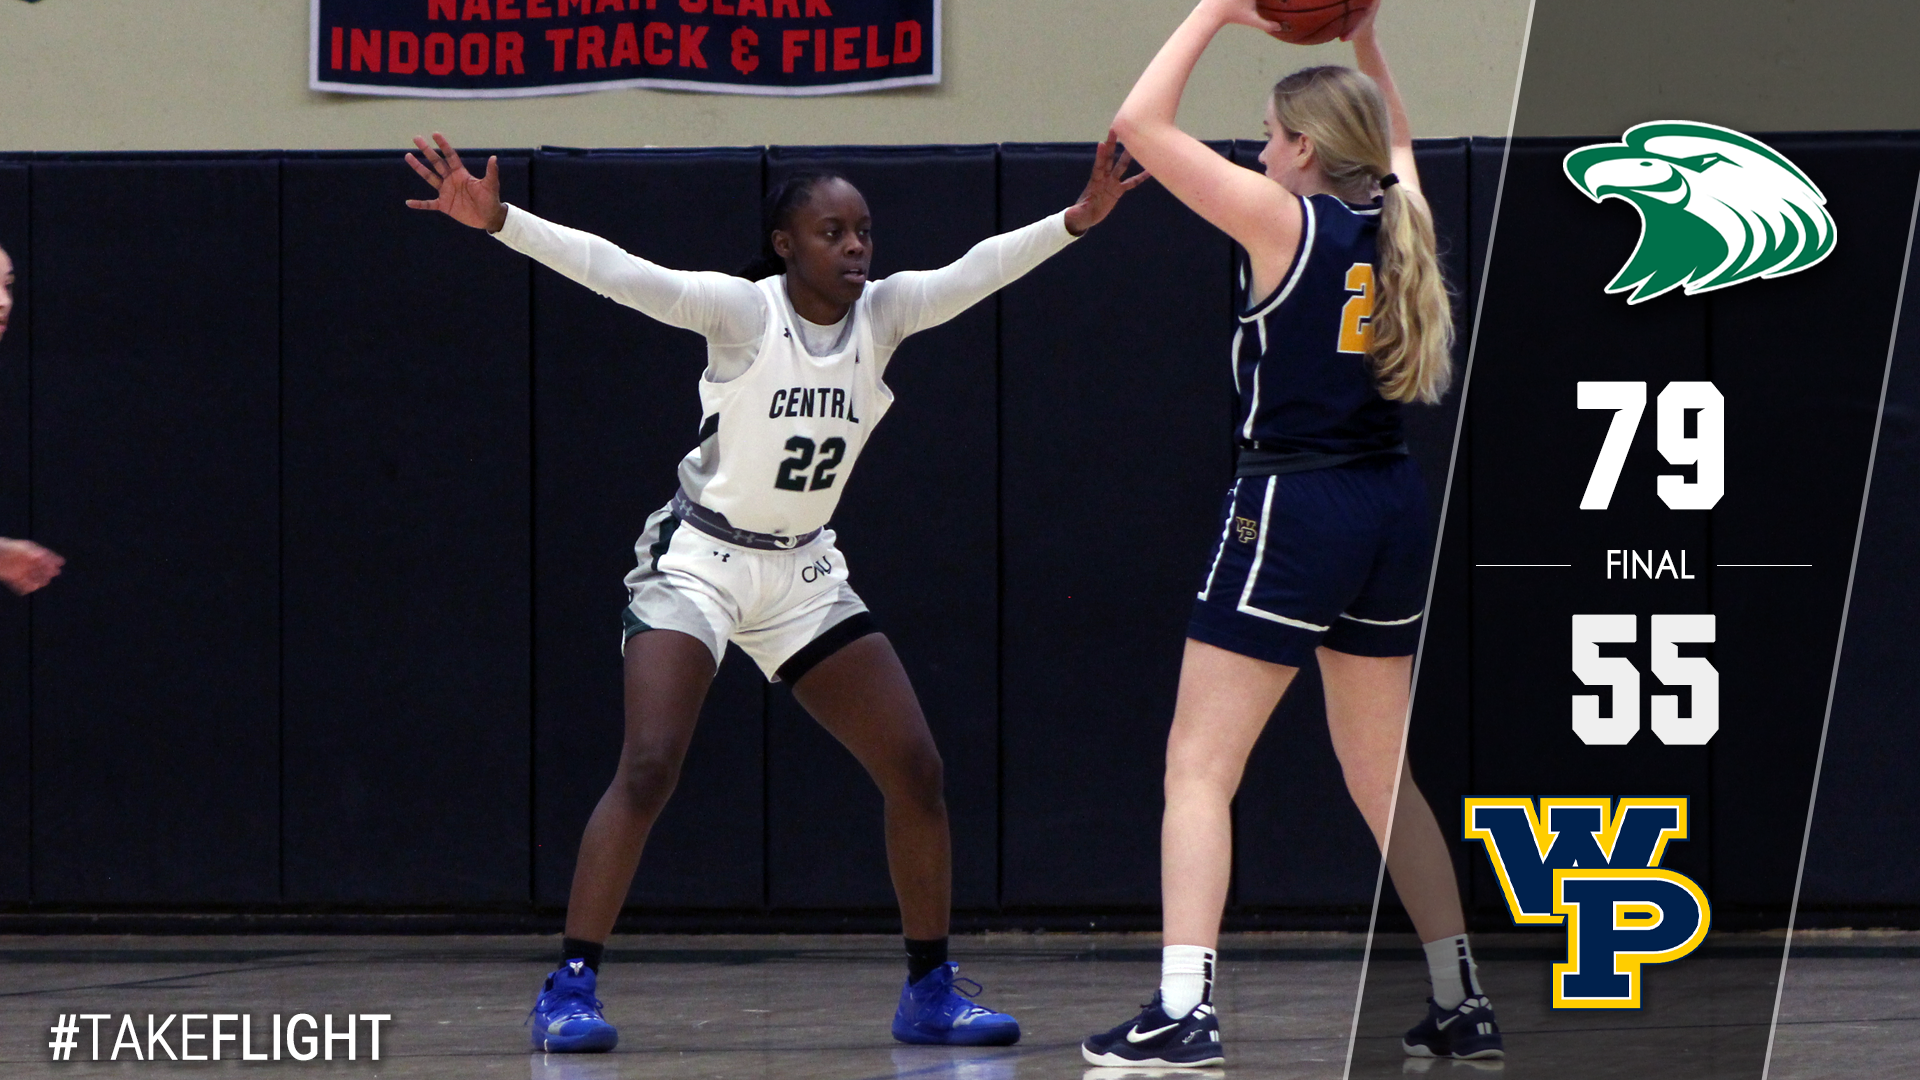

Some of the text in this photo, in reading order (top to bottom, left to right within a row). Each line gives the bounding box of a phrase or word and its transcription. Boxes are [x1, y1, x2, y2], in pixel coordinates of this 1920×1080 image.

[331, 19, 922, 76] INDOOR TRACK & FIELD
[775, 435, 846, 492] 22
